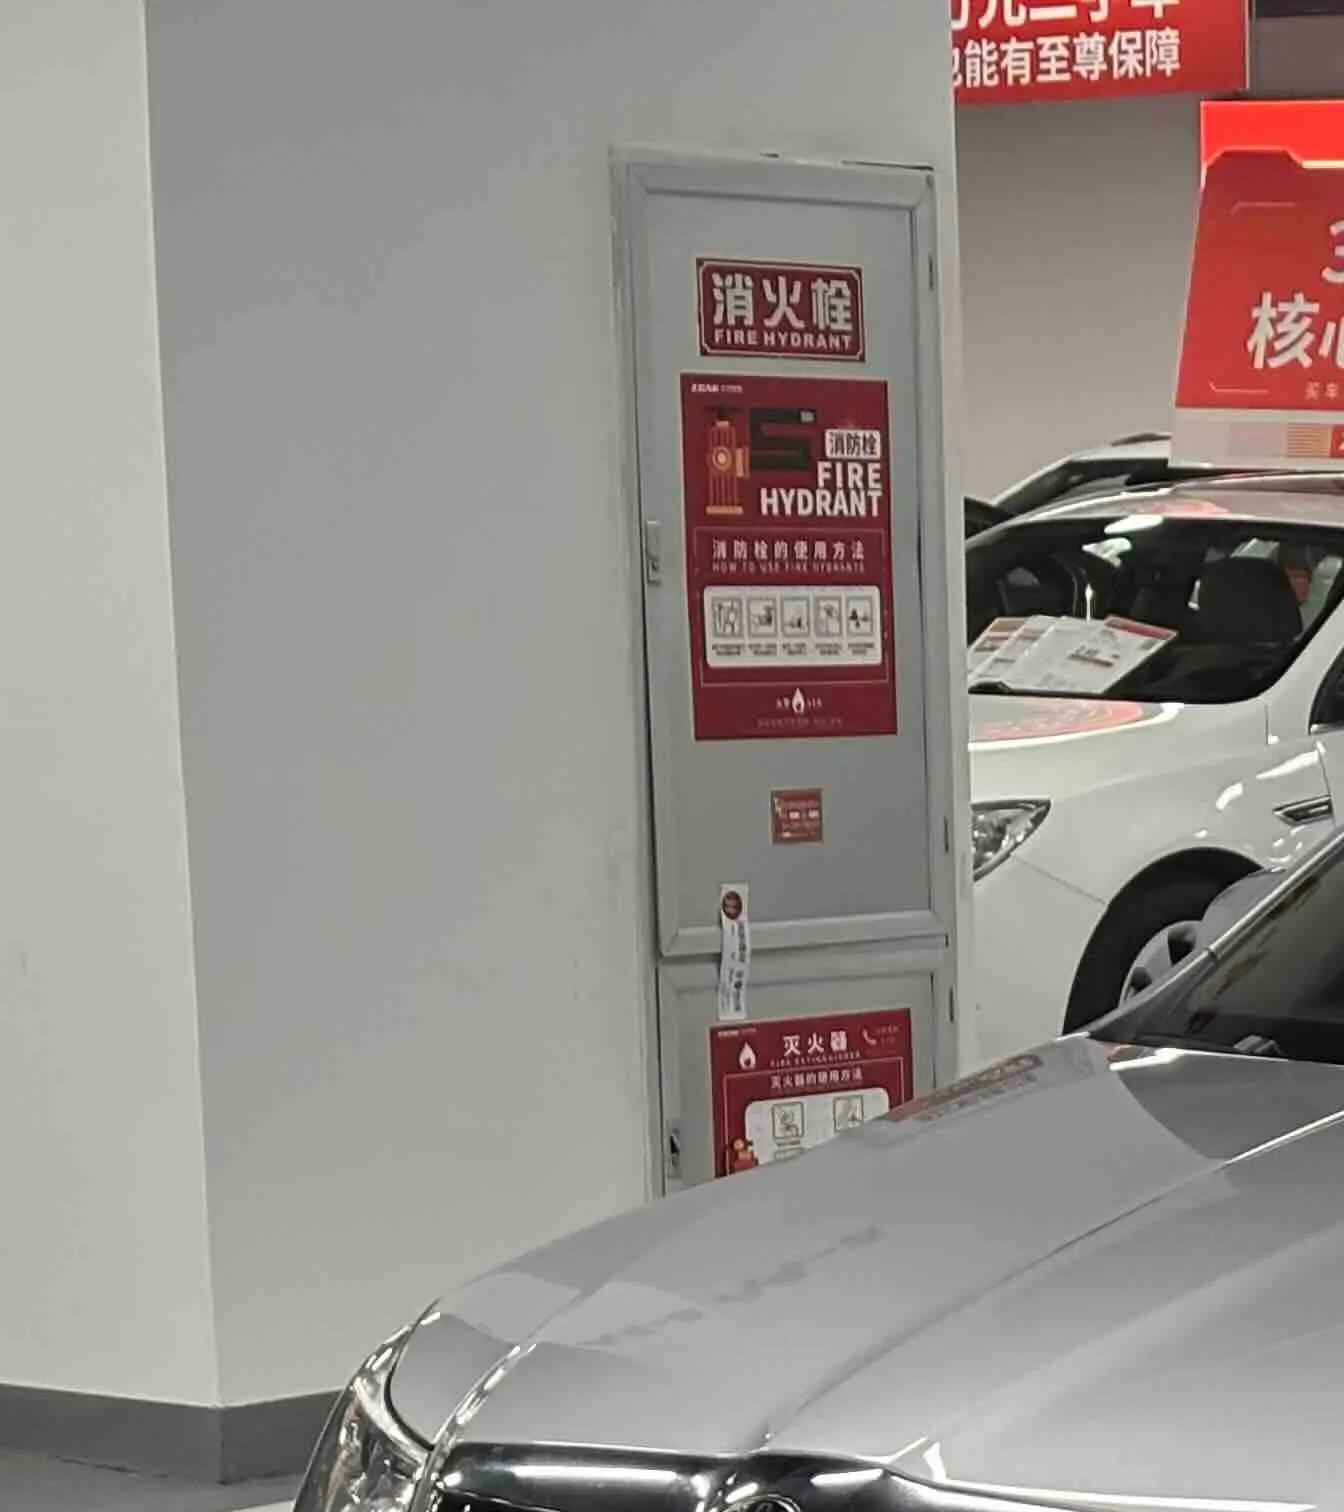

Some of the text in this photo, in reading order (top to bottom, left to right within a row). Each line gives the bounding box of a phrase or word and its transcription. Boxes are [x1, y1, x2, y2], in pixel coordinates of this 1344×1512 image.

[712, 272, 853, 331] 消火栓
[714, 329, 853, 350] FIRE HYDRANT
[828, 431, 878, 457] 消防栓
[817, 461, 883, 489] FIRE
[760, 488, 883, 517] HYDRANT
[712, 539, 865, 561] 消防栓的使用方法
[782, 1031, 848, 1057] 灭火器
